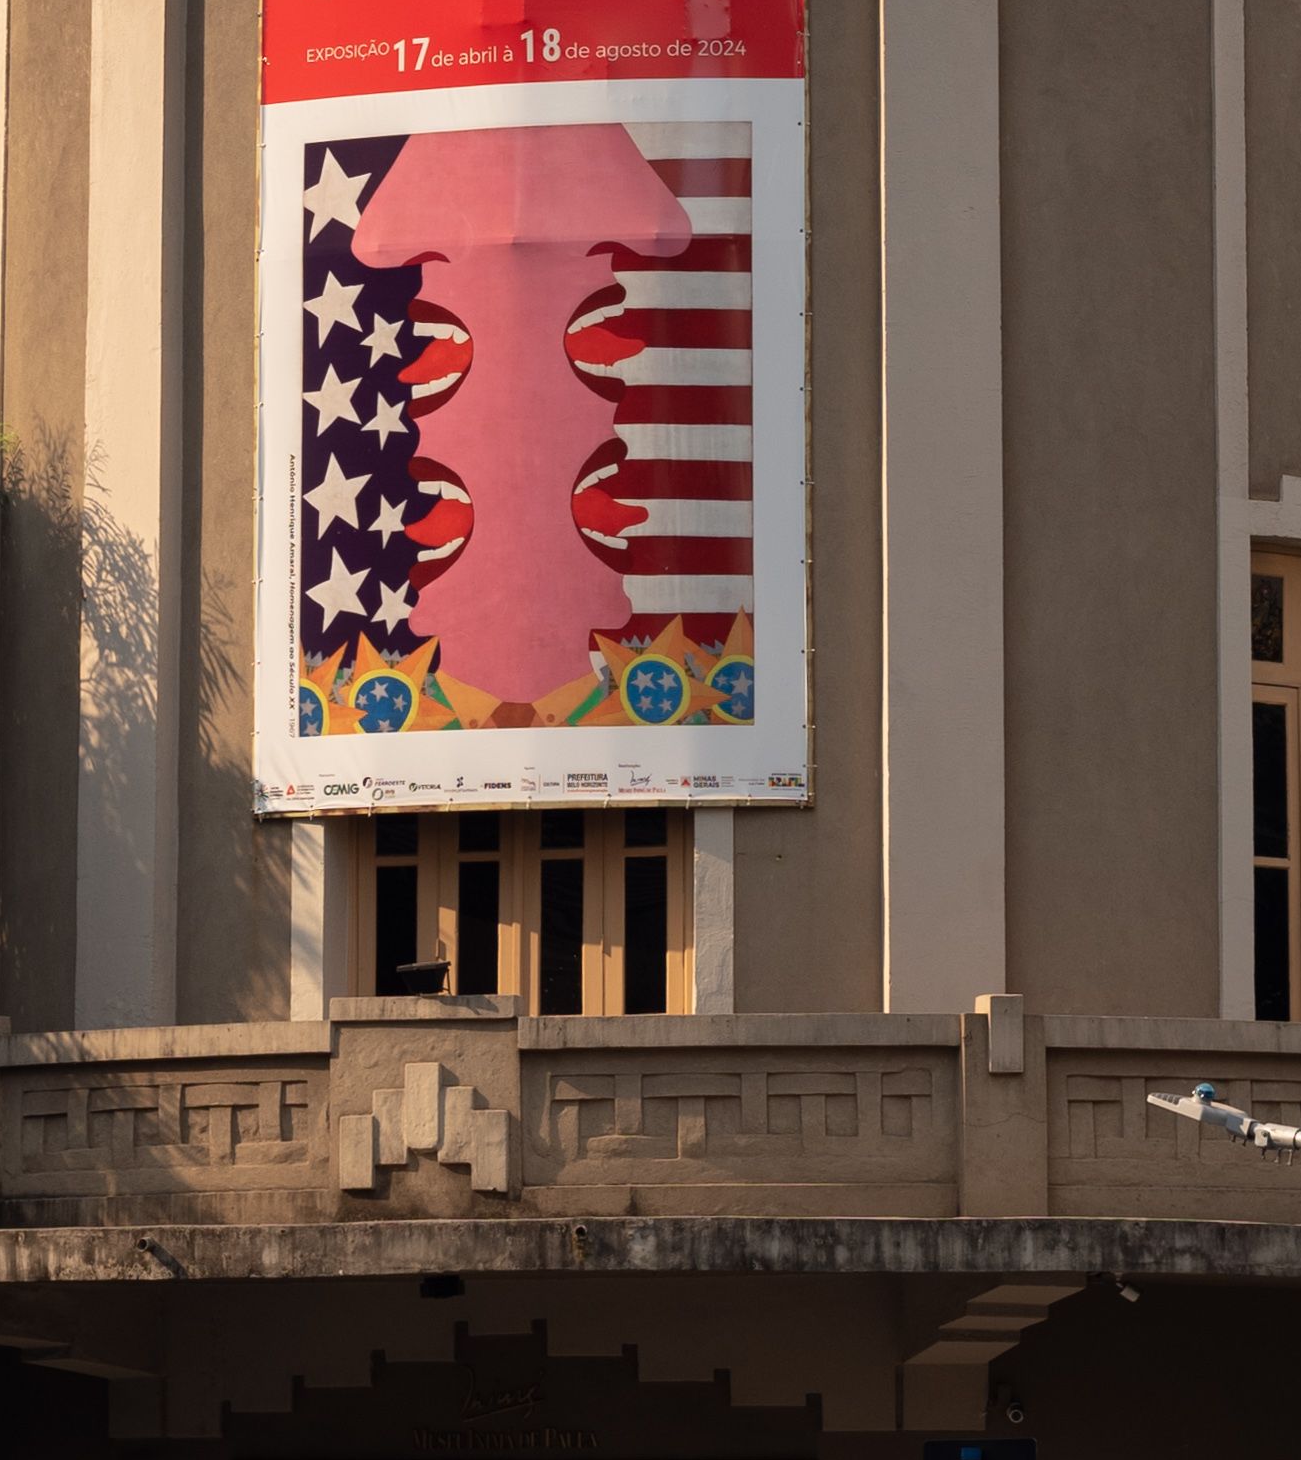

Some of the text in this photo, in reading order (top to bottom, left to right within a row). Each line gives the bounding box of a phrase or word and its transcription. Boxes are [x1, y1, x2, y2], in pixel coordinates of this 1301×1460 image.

[306, 28, 747, 72] EXPOSIÇÃO 17 de abril à 18 de agosto de 2024
[289, 697, 295, 710] XX
[567, 774, 609, 782] PREFEITURA
[323, 783, 360, 796] CEMIG
